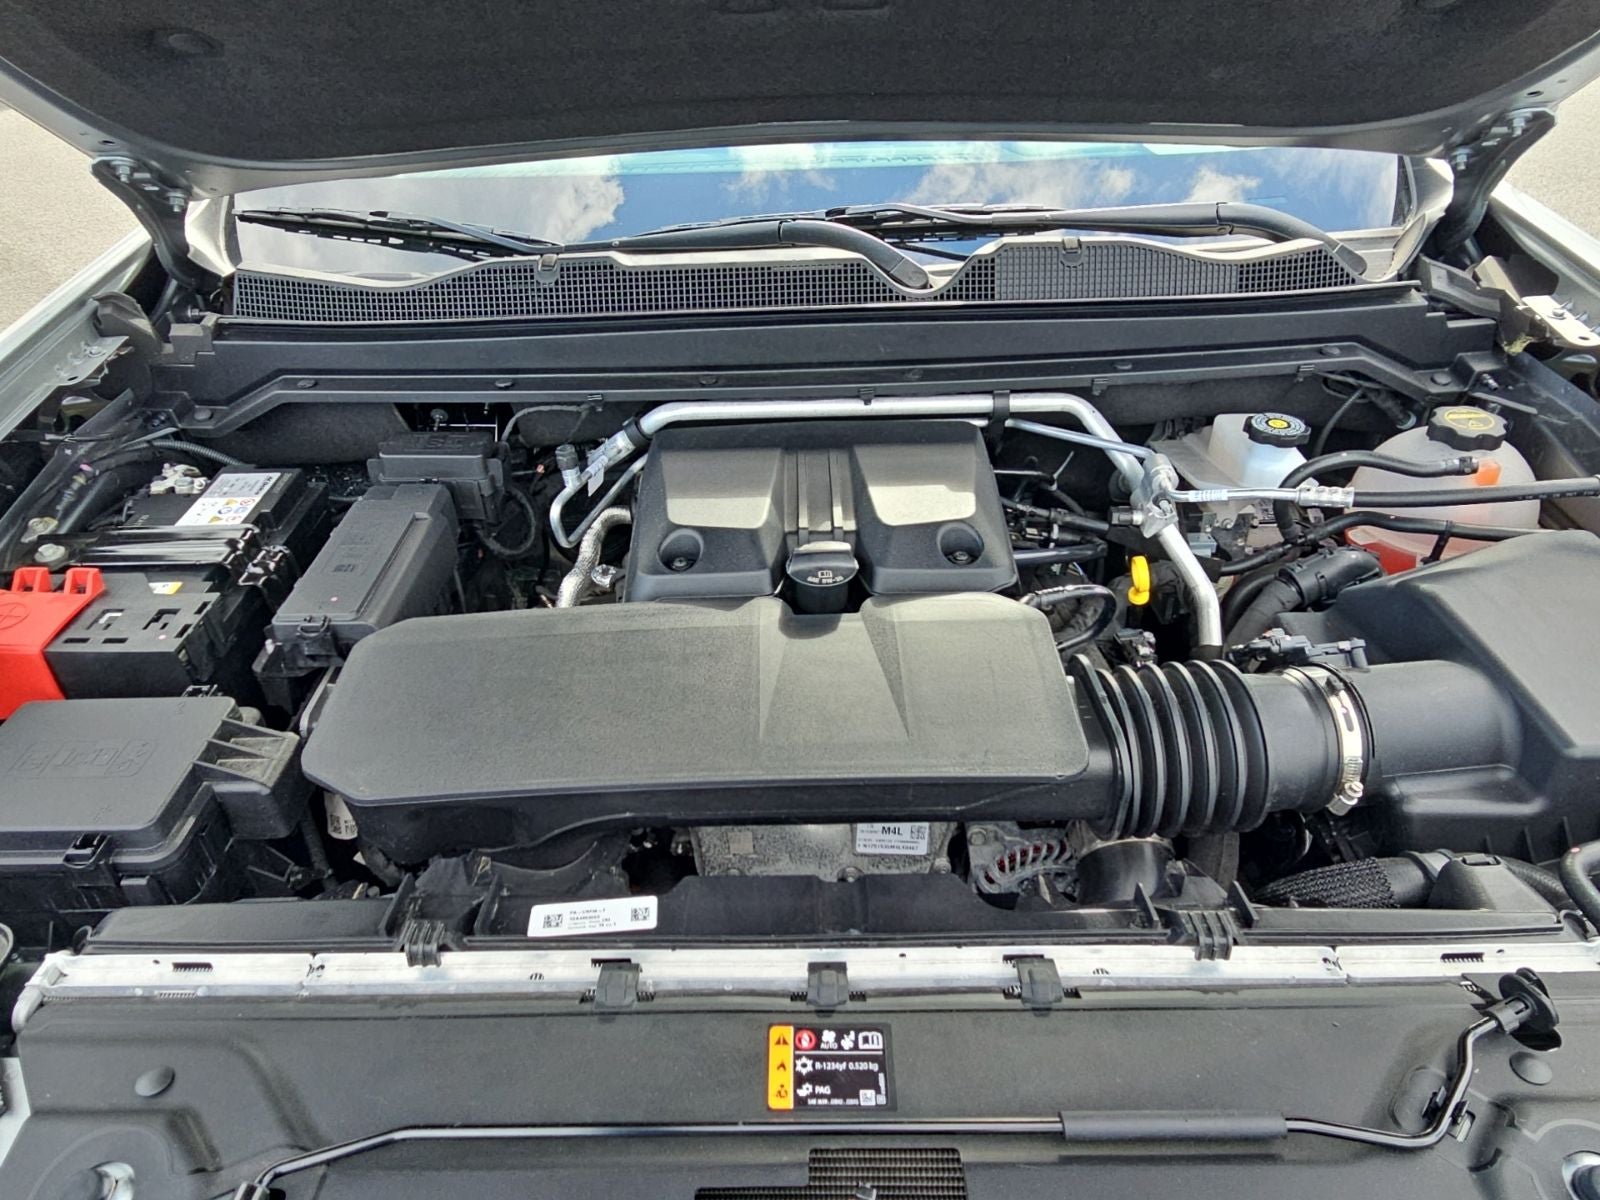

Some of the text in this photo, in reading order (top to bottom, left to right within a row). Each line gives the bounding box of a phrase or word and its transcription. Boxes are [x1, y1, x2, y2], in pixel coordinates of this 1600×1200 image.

[881, 826, 903, 836] M4L
[820, 1041, 838, 1049] AUTO
[815, 1061, 847, 1072] R-1234yf
[869, 1061, 879, 1072] kg
[815, 1085, 831, 1095] PAG
